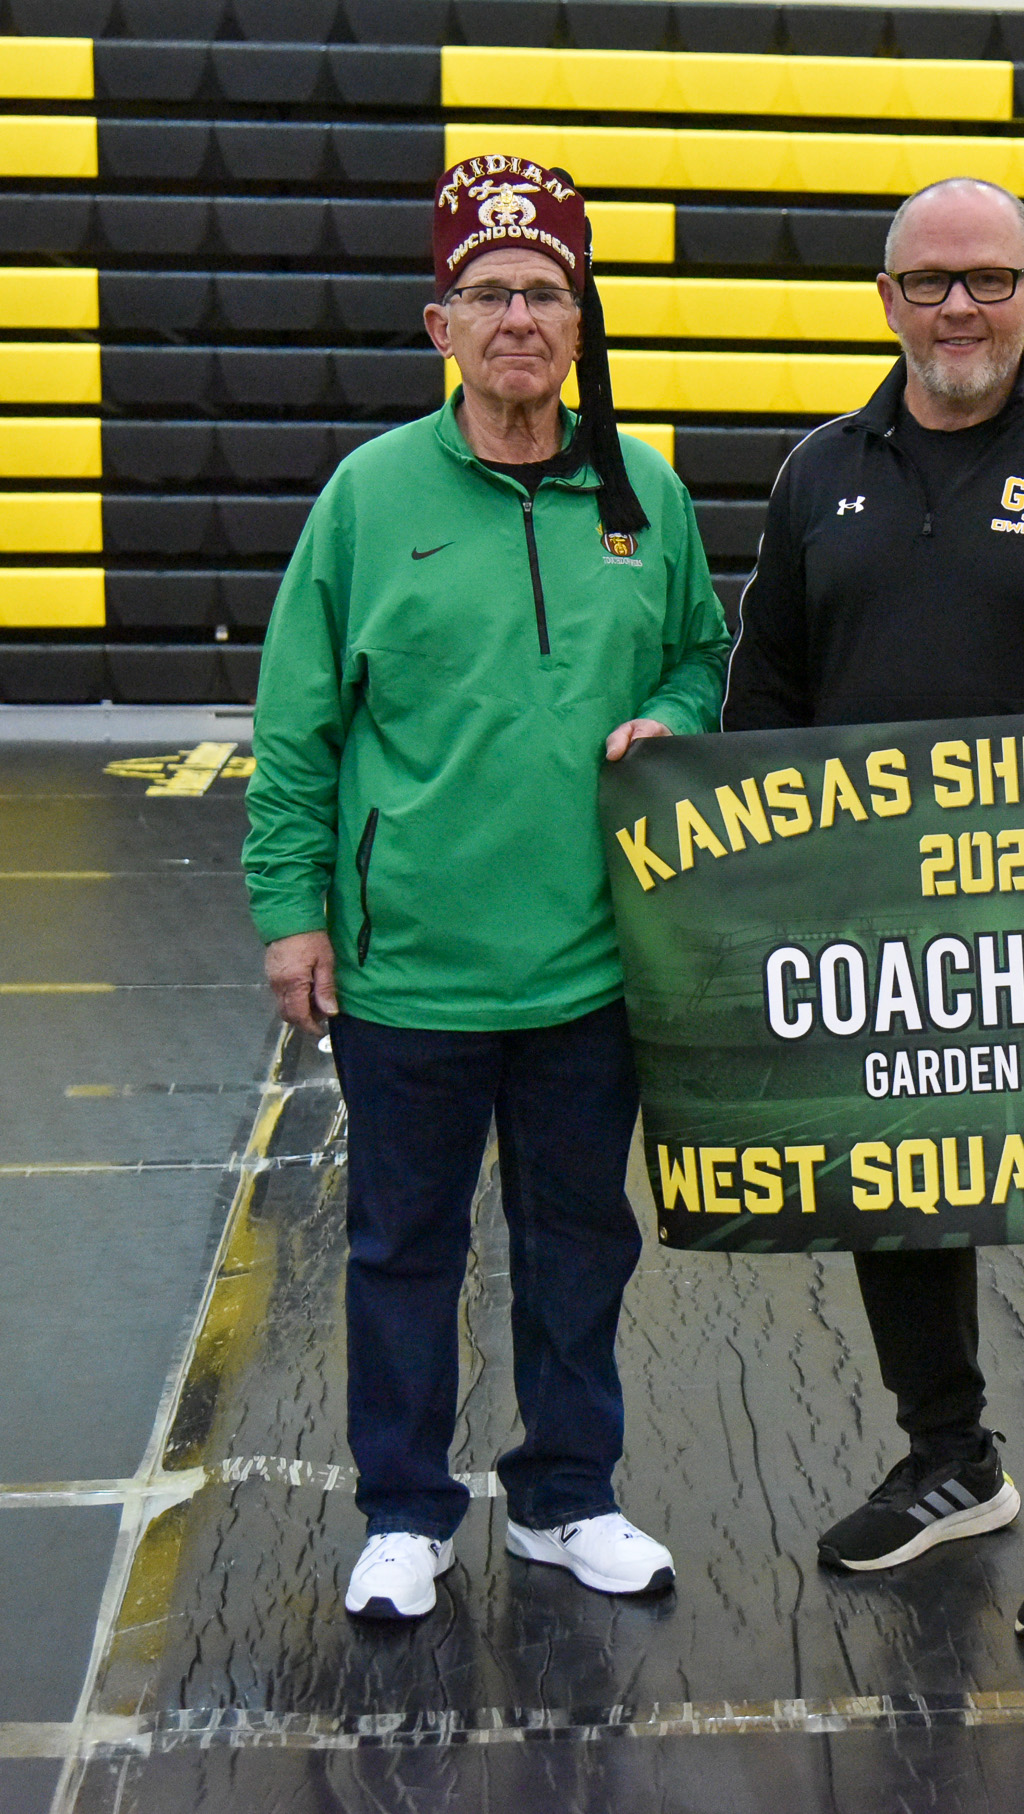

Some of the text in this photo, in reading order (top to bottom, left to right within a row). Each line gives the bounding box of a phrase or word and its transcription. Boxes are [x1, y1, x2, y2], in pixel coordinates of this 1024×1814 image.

[438, 154, 576, 214] MIDIAN
[446, 224, 577, 271] TOUCHDOWNERS
[615, 748, 912, 891] KANSAS
[864, 1044, 1020, 1099] GARDEN
[657, 1144, 826, 1214] WEST
